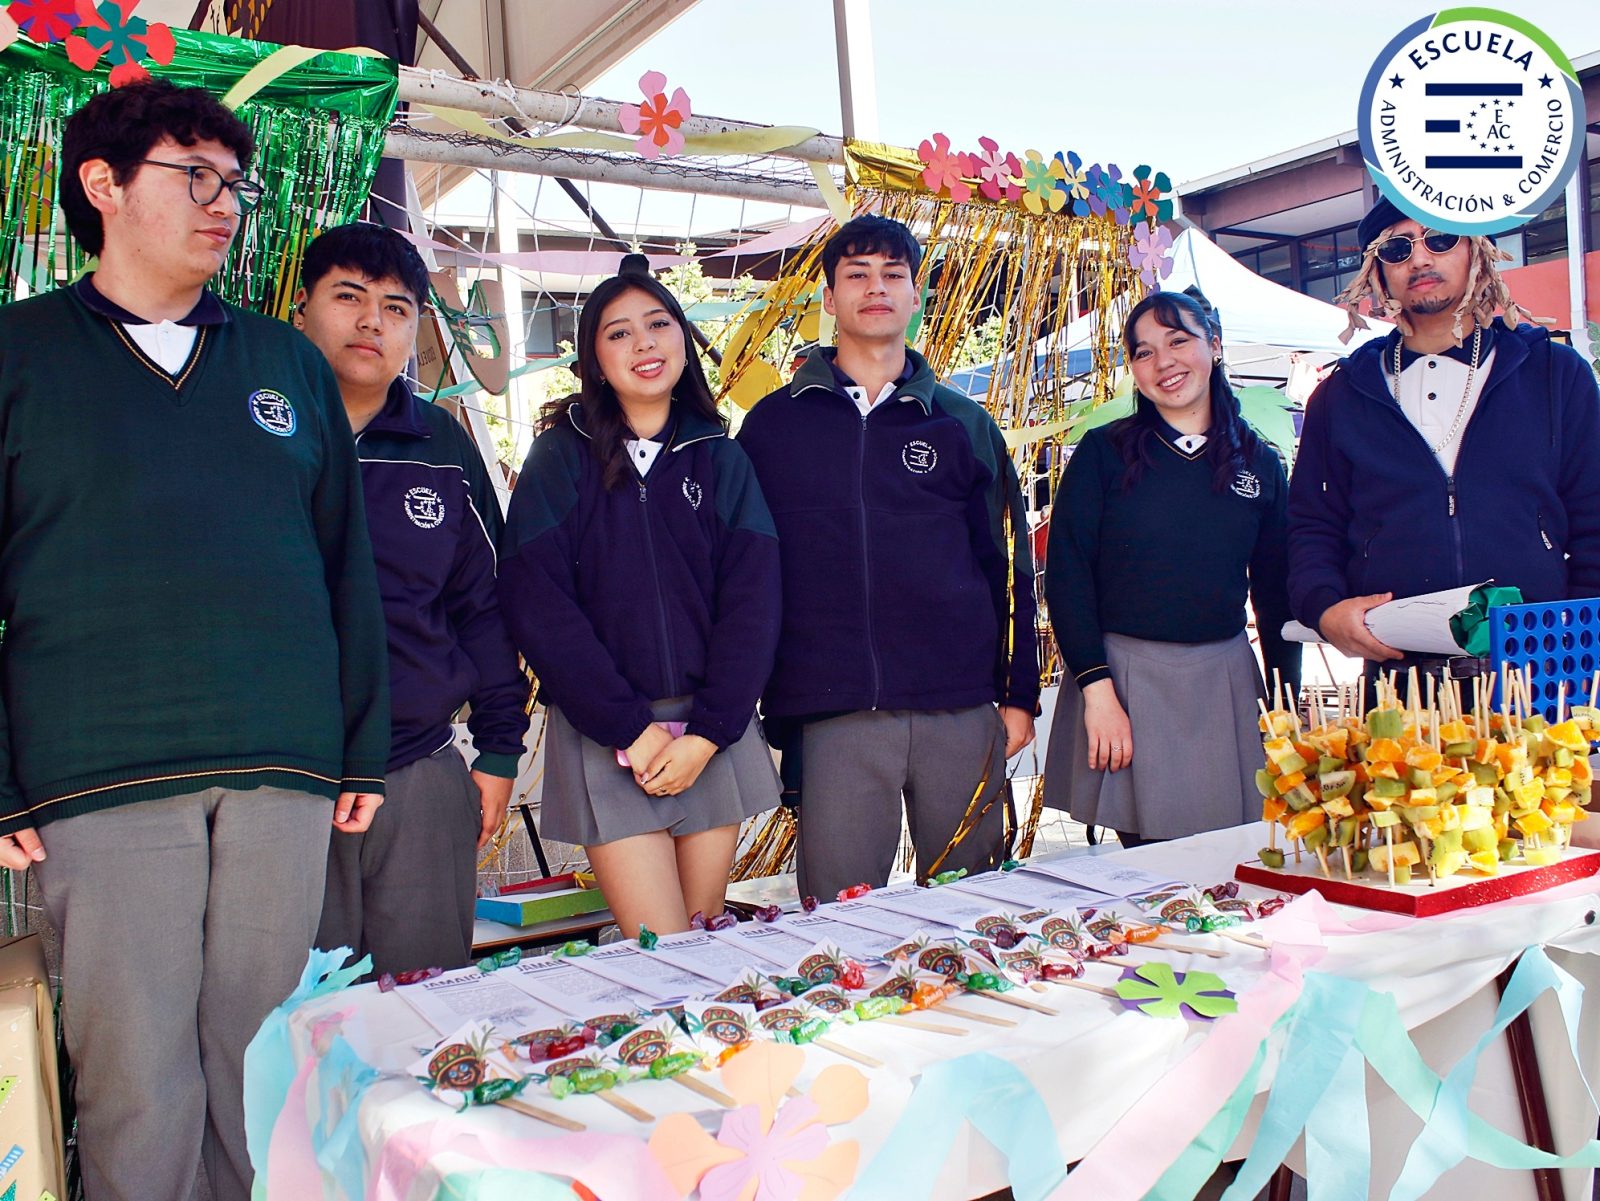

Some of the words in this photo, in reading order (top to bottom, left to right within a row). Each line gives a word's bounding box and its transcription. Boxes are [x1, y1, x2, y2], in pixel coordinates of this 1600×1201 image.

[256, 393, 284, 406] ESCUELA
[909, 440, 932, 450] ESCUELA
[409, 486, 437, 498] ESCUELA
[422, 971, 491, 988] JAMAICA
